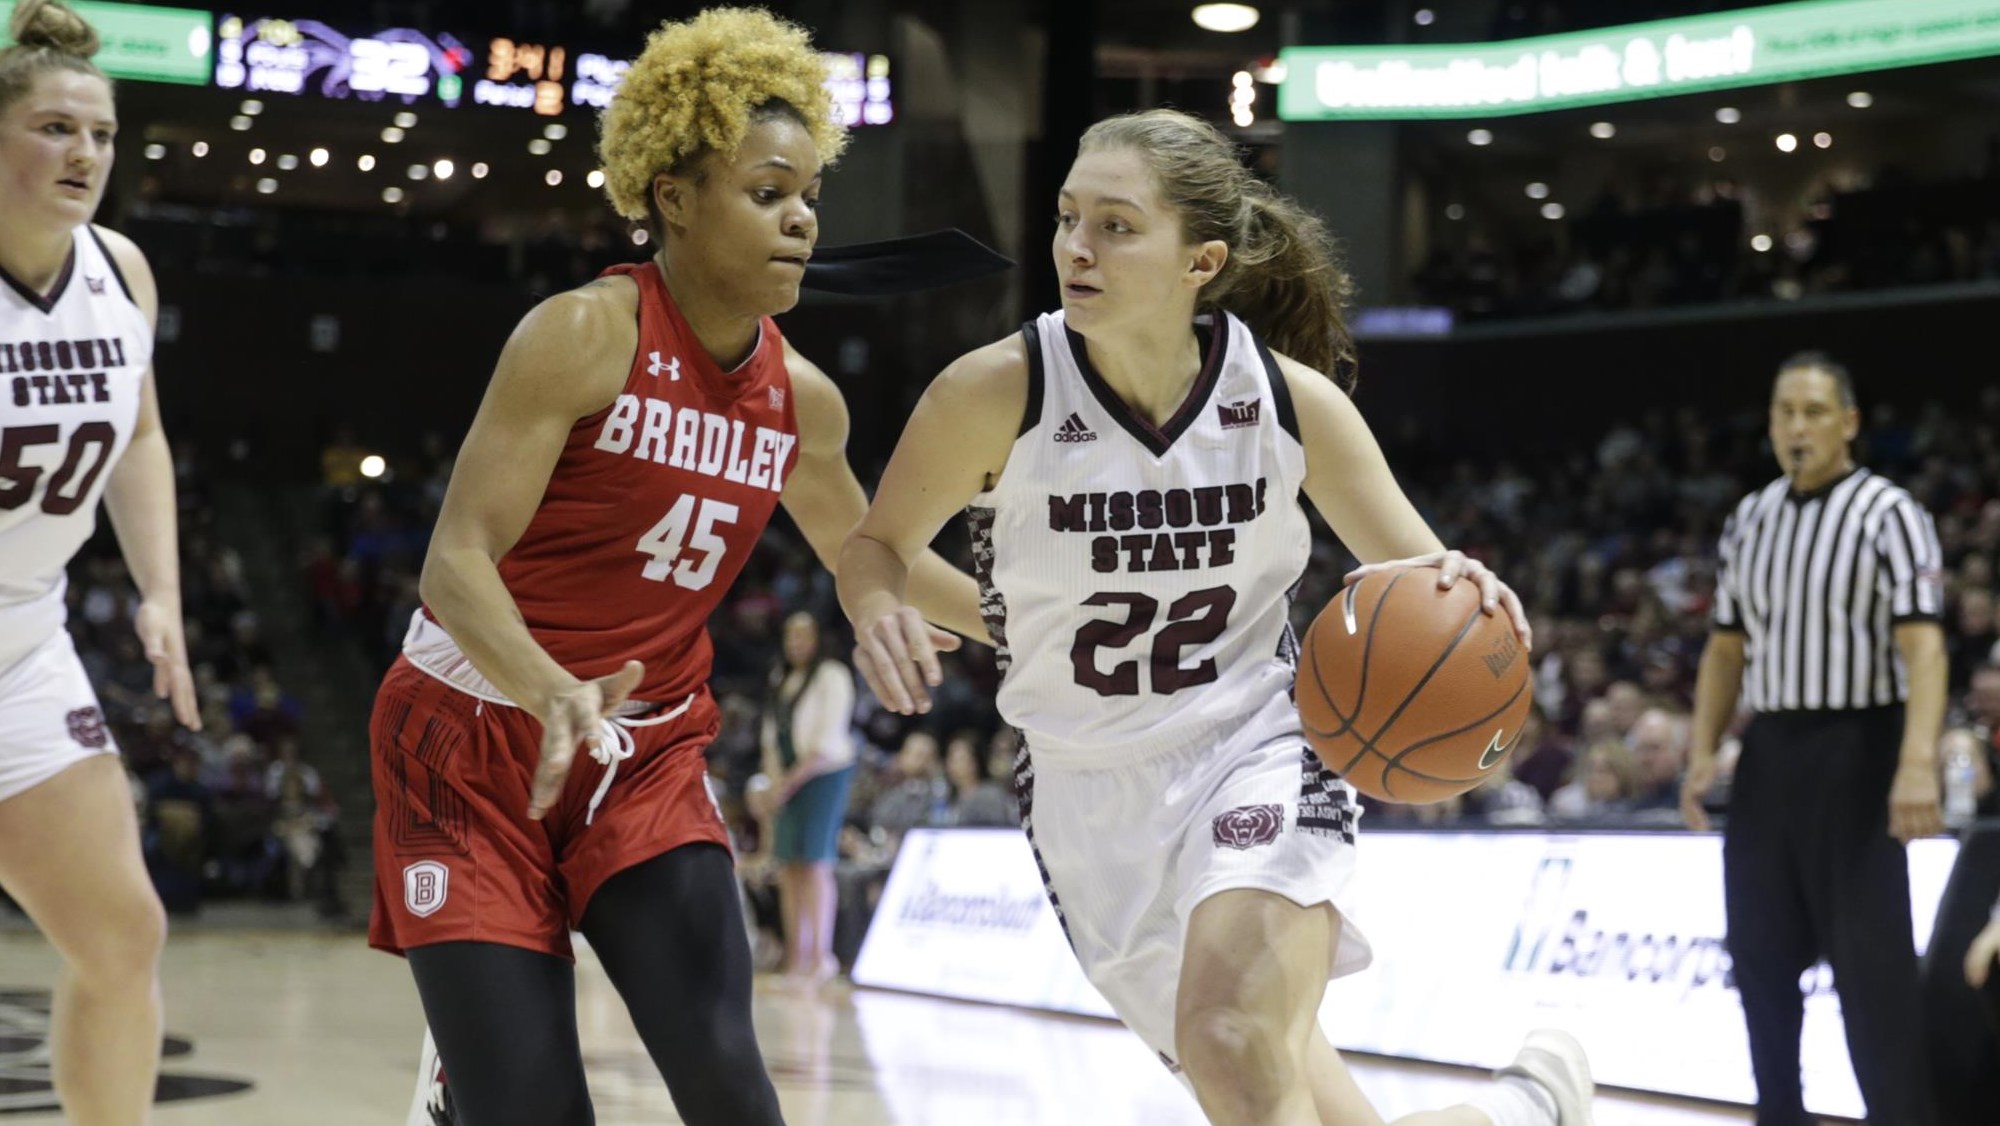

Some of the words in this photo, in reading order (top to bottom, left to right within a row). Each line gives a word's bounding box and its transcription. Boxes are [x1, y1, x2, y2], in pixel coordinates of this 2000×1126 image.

[0, 338, 125, 374] ISSOURI
[12, 372, 111, 407] STATE
[0, 420, 116, 515] 50
[593, 393, 796, 493] BRADLEY
[1053, 428, 1097, 443] adidas
[635, 493, 739, 592] 45
[1091, 528, 1236, 573] STATE
[1070, 584, 1237, 697] 22
